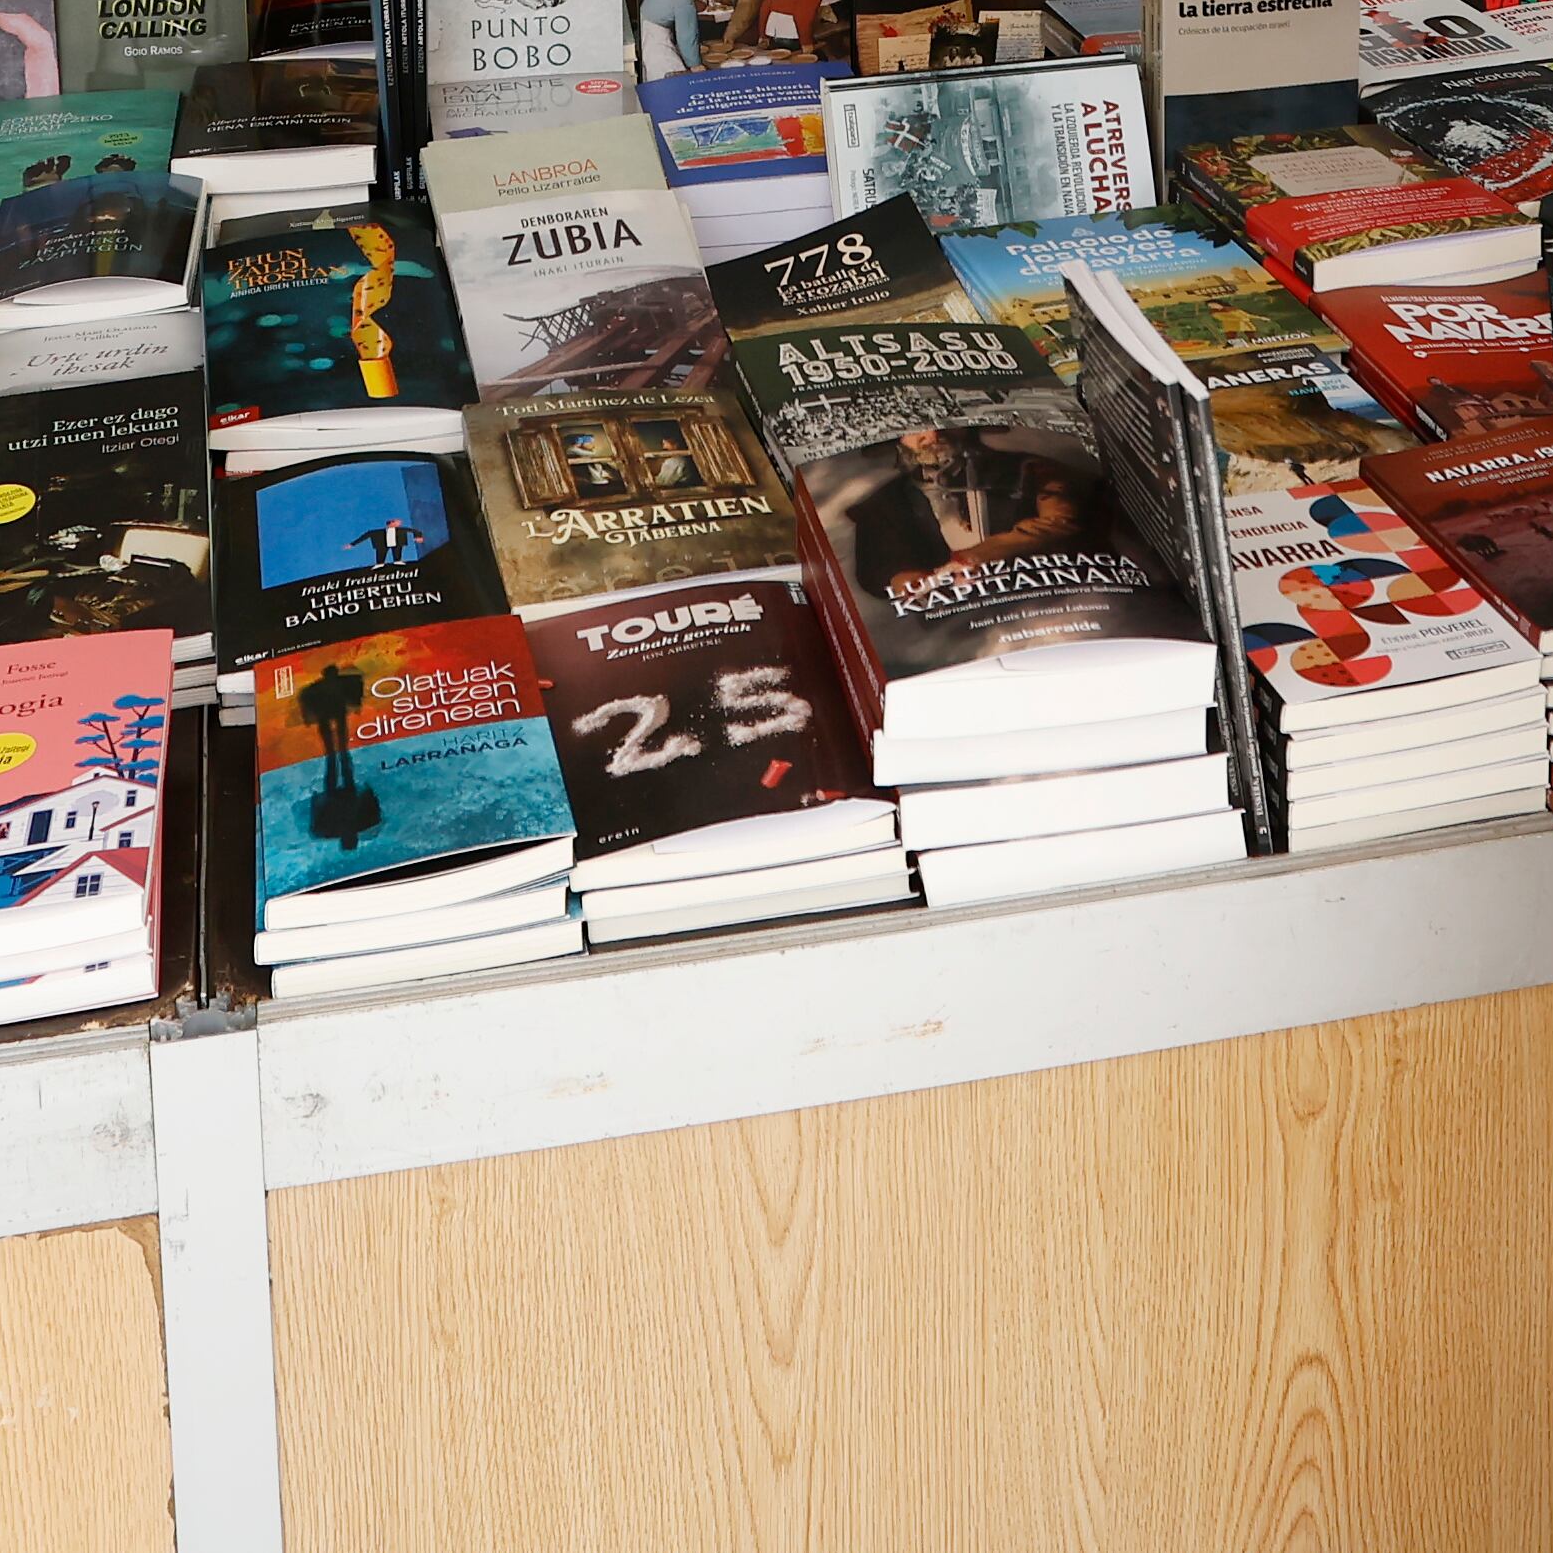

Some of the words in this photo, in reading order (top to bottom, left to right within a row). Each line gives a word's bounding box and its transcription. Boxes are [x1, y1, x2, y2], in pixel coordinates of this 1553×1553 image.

[1179, 2, 1197, 19] la
[1202, 0, 1253, 16] tierra
[101, 19, 207, 39] CALLING
[472, 15, 571, 39] PUNTO
[472, 43, 572, 71] BOBO
[520, 206, 609, 230] DENBORAREN
[501, 219, 643, 268] ZUBIA
[779, 332, 1004, 366] ALTSASU
[782, 351, 1018, 386] 1950-2000
[8, 435, 47, 452] utzi
[53, 428, 106, 446] nuen
[110, 417, 179, 439] lekuan
[53, 418, 99, 433] Ezer
[104, 415, 126, 428] ez
[129, 405, 179, 425] dago
[884, 574, 955, 600] LUIS
[964, 552, 1139, 583] LIZARRAGA
[891, 566, 1111, 618] KAPITAINA
[285, 606, 363, 628] BAINO
[369, 591, 442, 612] LEHEN
[310, 582, 413, 609] LEHERTU
[577, 594, 764, 653] TOURÉ
[7, 661, 57, 675] Fosse
[371, 661, 515, 699] Olatuak
[392, 681, 516, 714] sutzen
[356, 698, 521, 741] direnean
